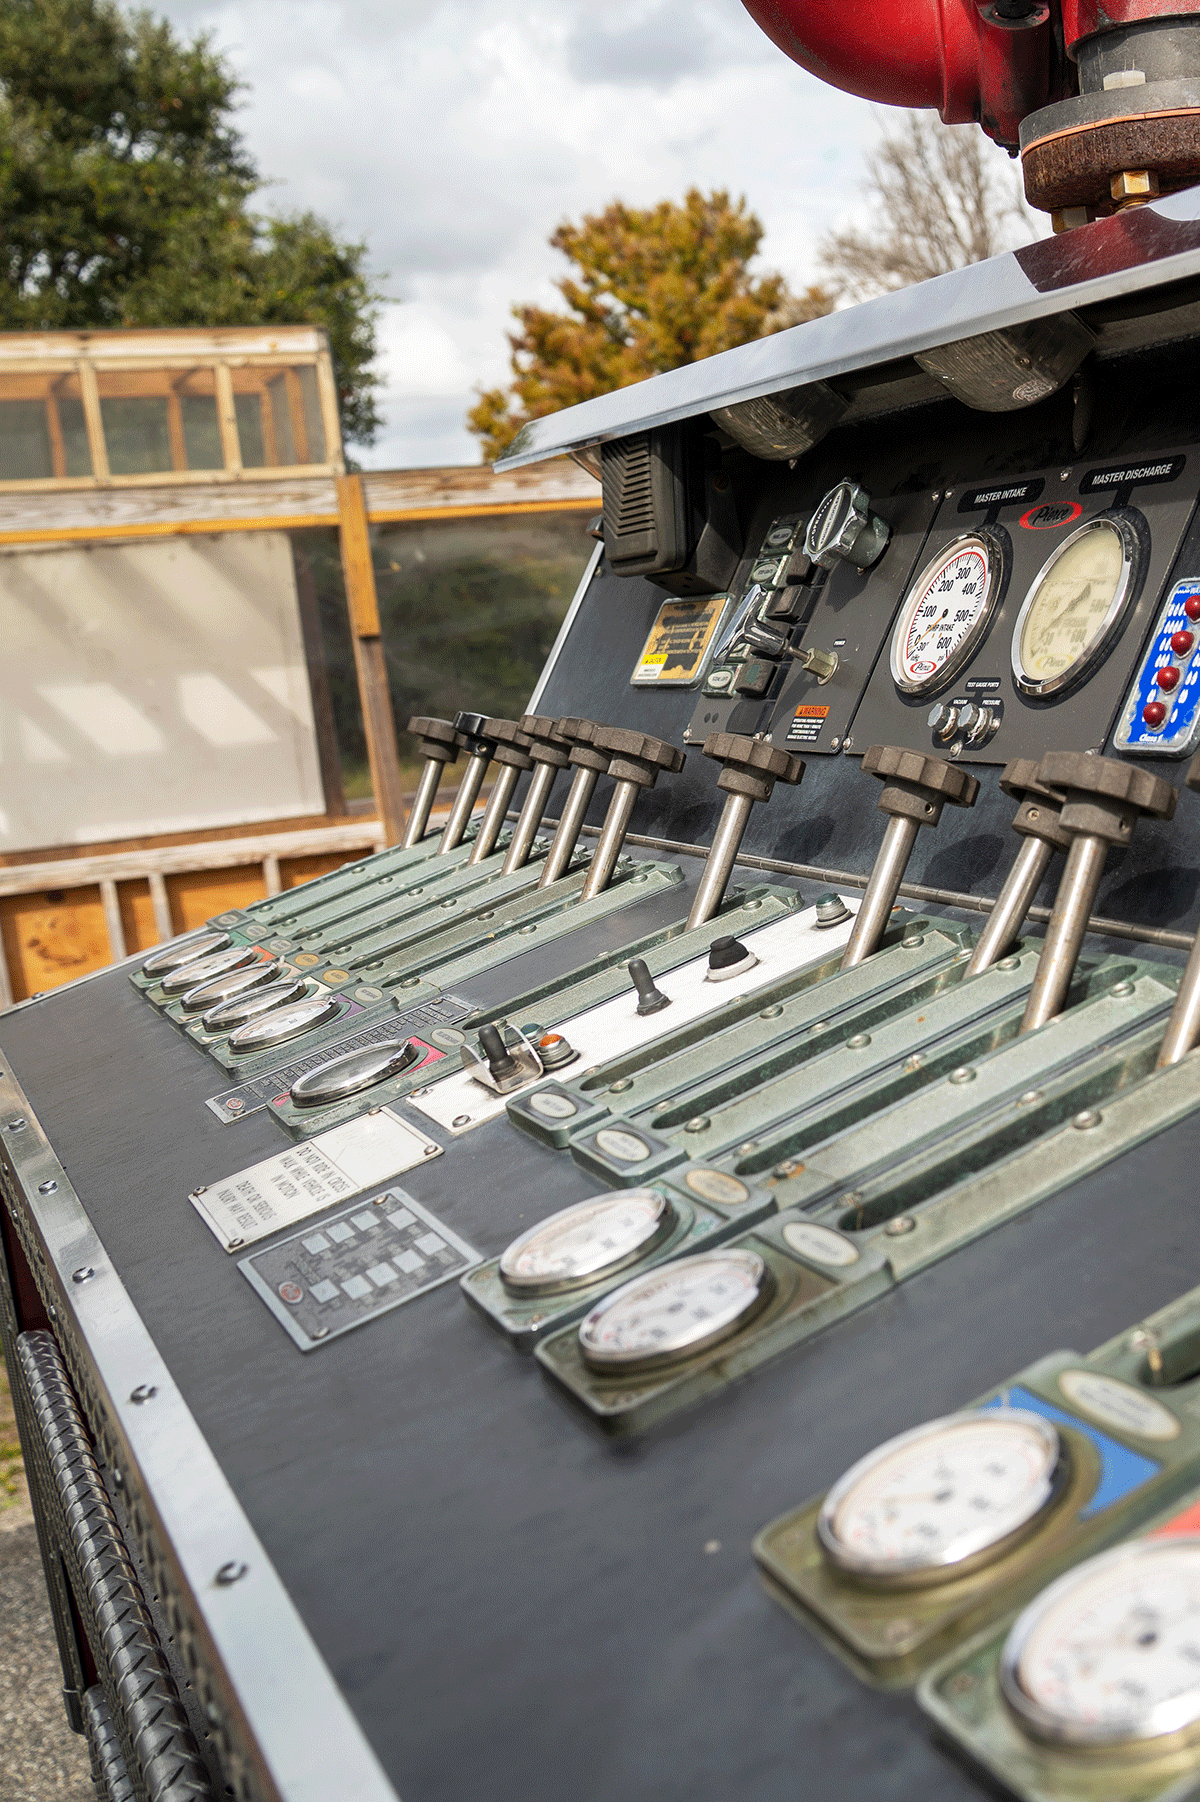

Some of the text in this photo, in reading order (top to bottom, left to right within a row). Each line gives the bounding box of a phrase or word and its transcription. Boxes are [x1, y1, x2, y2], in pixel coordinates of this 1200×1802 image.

[1091, 463, 1173, 486] MASTER DISCHARGE
[974, 486, 1028, 504] MASTER INTAKE
[1032, 506, 1070, 526] Pierce
[955, 567, 972, 579] 300
[938, 579, 954, 592] 200
[961, 582, 977, 595] 400
[922, 605, 938, 617] 100
[953, 609, 969, 622] 500
[936, 637, 952, 649] 600
[327, 1177, 350, 1193] CROSS
